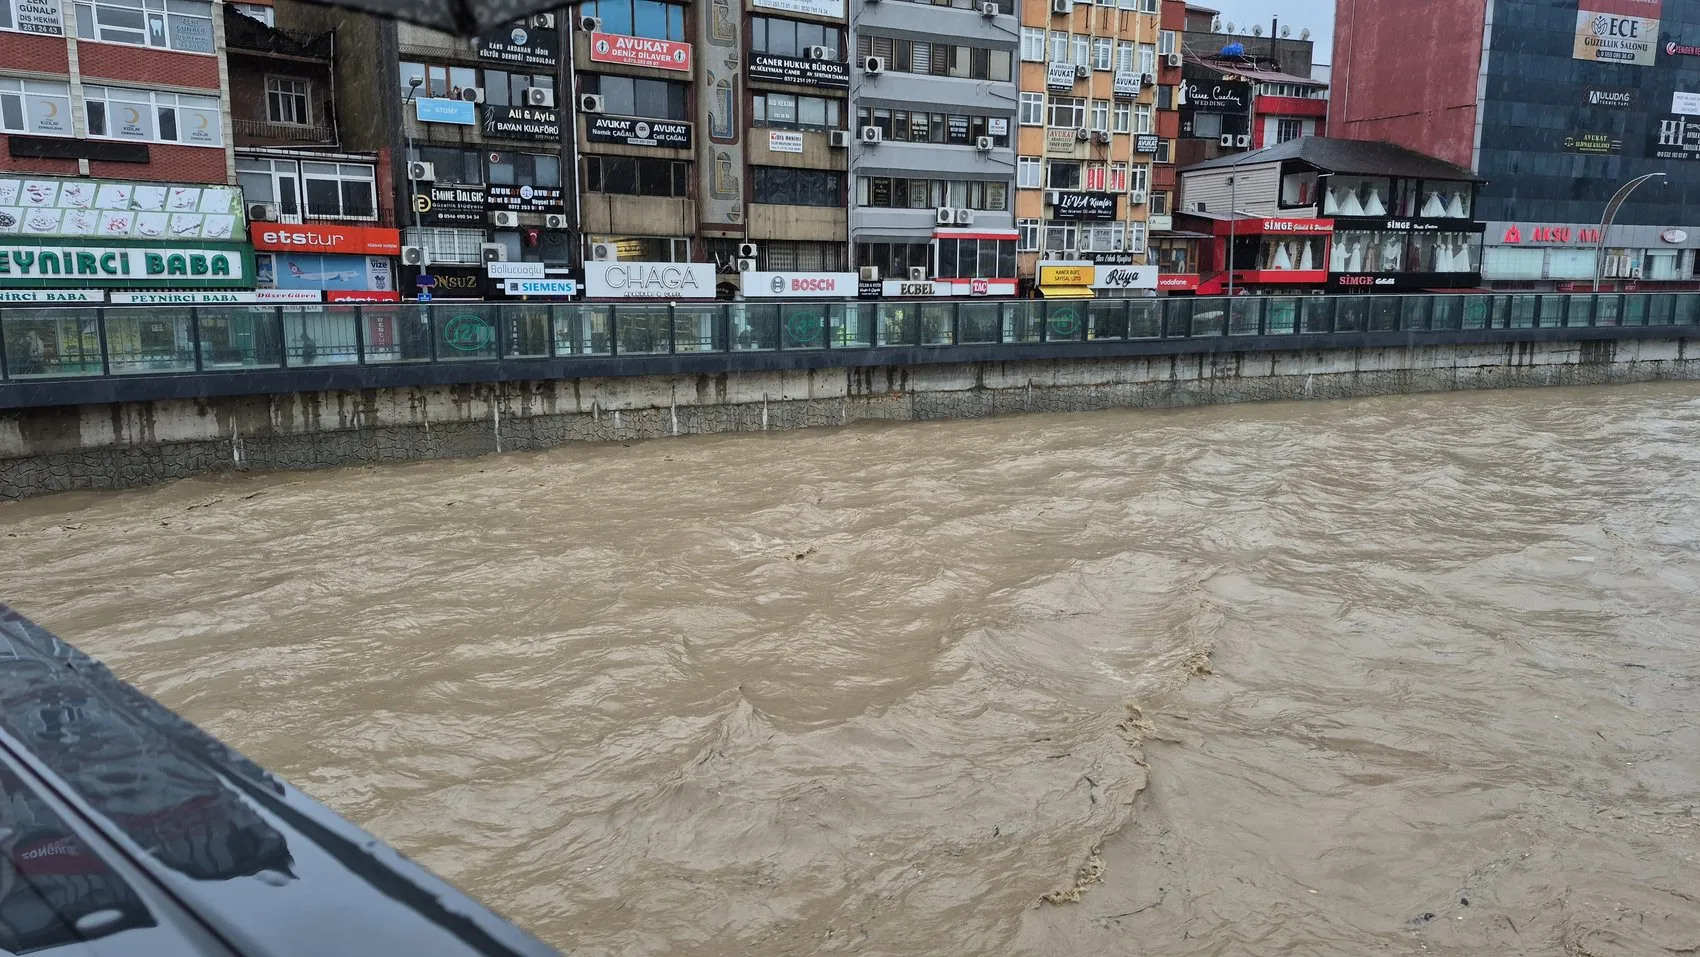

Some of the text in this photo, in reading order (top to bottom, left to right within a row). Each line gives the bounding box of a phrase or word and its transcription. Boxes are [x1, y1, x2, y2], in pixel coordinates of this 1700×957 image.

[19, 4, 57, 15] GÜNALP
[20, 13, 32, 22] DİŞ
[1608, 17, 1639, 38] ECE
[488, 42, 503, 50] KARS
[615, 37, 670, 53] AVUKAT
[1620, 40, 1648, 52] SALONU
[479, 48, 499, 58] KÜLTÜR
[526, 55, 556, 65] ZONGULDAK
[611, 48, 672, 62] DENİZ DİLAVER
[756, 56, 843, 73] CANER HUKUK BÜROSU
[1049, 68, 1074, 78] AVUKAT
[1115, 77, 1140, 86] AVUKAT
[1600, 91, 1630, 102] ULUDAĞ
[508, 108, 556, 123] Ali & Ayla
[497, 122, 559, 135] BAYAN KUAFÖRÜ
[595, 118, 631, 130] AVUKAT
[653, 124, 686, 134] AVUKAT
[1049, 130, 1075, 138] AVUKAT
[431, 188, 484, 205] EMİNE DALGIÇ
[490, 187, 520, 196] AVUKAT
[533, 189, 560, 197] AVUKAT
[1264, 219, 1293, 231] SİMGE
[1386, 219, 1411, 230] SİMGE
[263, 230, 344, 246] etstur
[1531, 225, 1572, 243] AKSU
[145, 252, 230, 275] BABA
[604, 264, 699, 289] CHAGA
[1105, 268, 1140, 288] Rüya
[1159, 278, 1188, 286] vodafone
[1339, 274, 1374, 285] SİMGE
[522, 282, 572, 292] SIEMENS
[791, 278, 835, 291] BOSCH
[900, 283, 935, 295] ECBEL
[973, 282, 987, 293] TAÇ
[46, 292, 88, 301] BABA
[131, 293, 239, 303] PEYNİRCİ BABA
